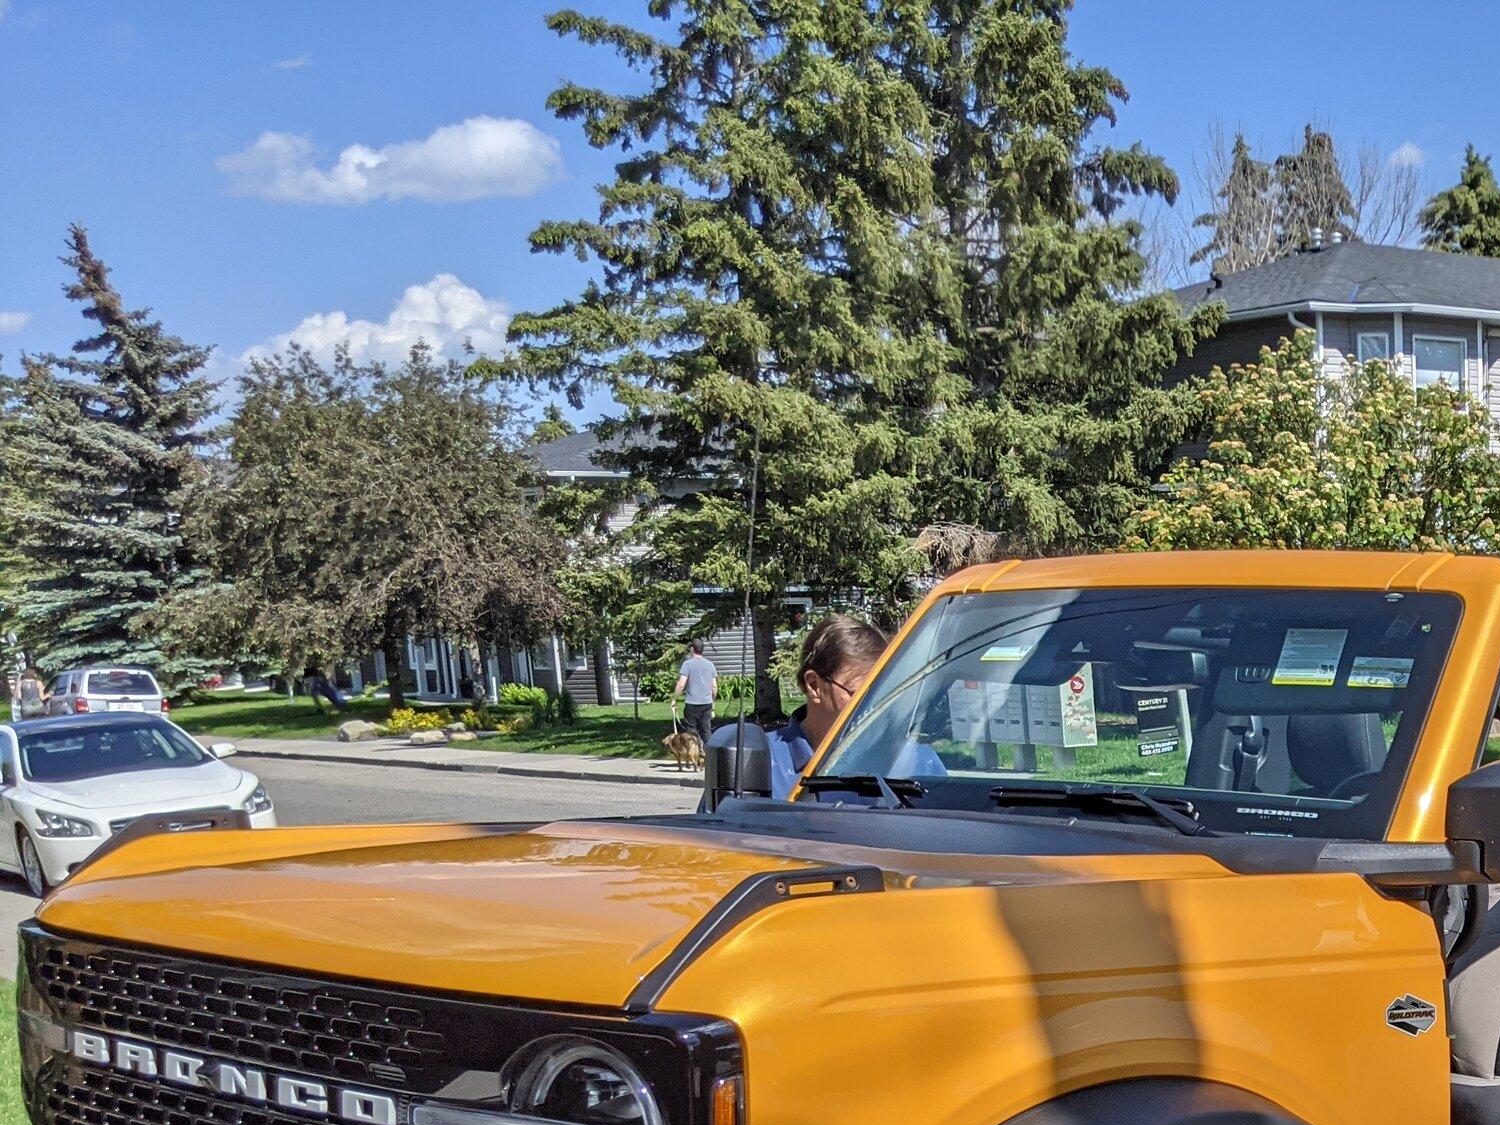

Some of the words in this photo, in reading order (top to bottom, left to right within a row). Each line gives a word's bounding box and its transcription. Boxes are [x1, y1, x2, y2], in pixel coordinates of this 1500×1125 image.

[1137, 698, 1162, 706] CENTURY
[1236, 808, 1319, 819] BRONCO
[1389, 1010, 1435, 1020] WILDTRAK
